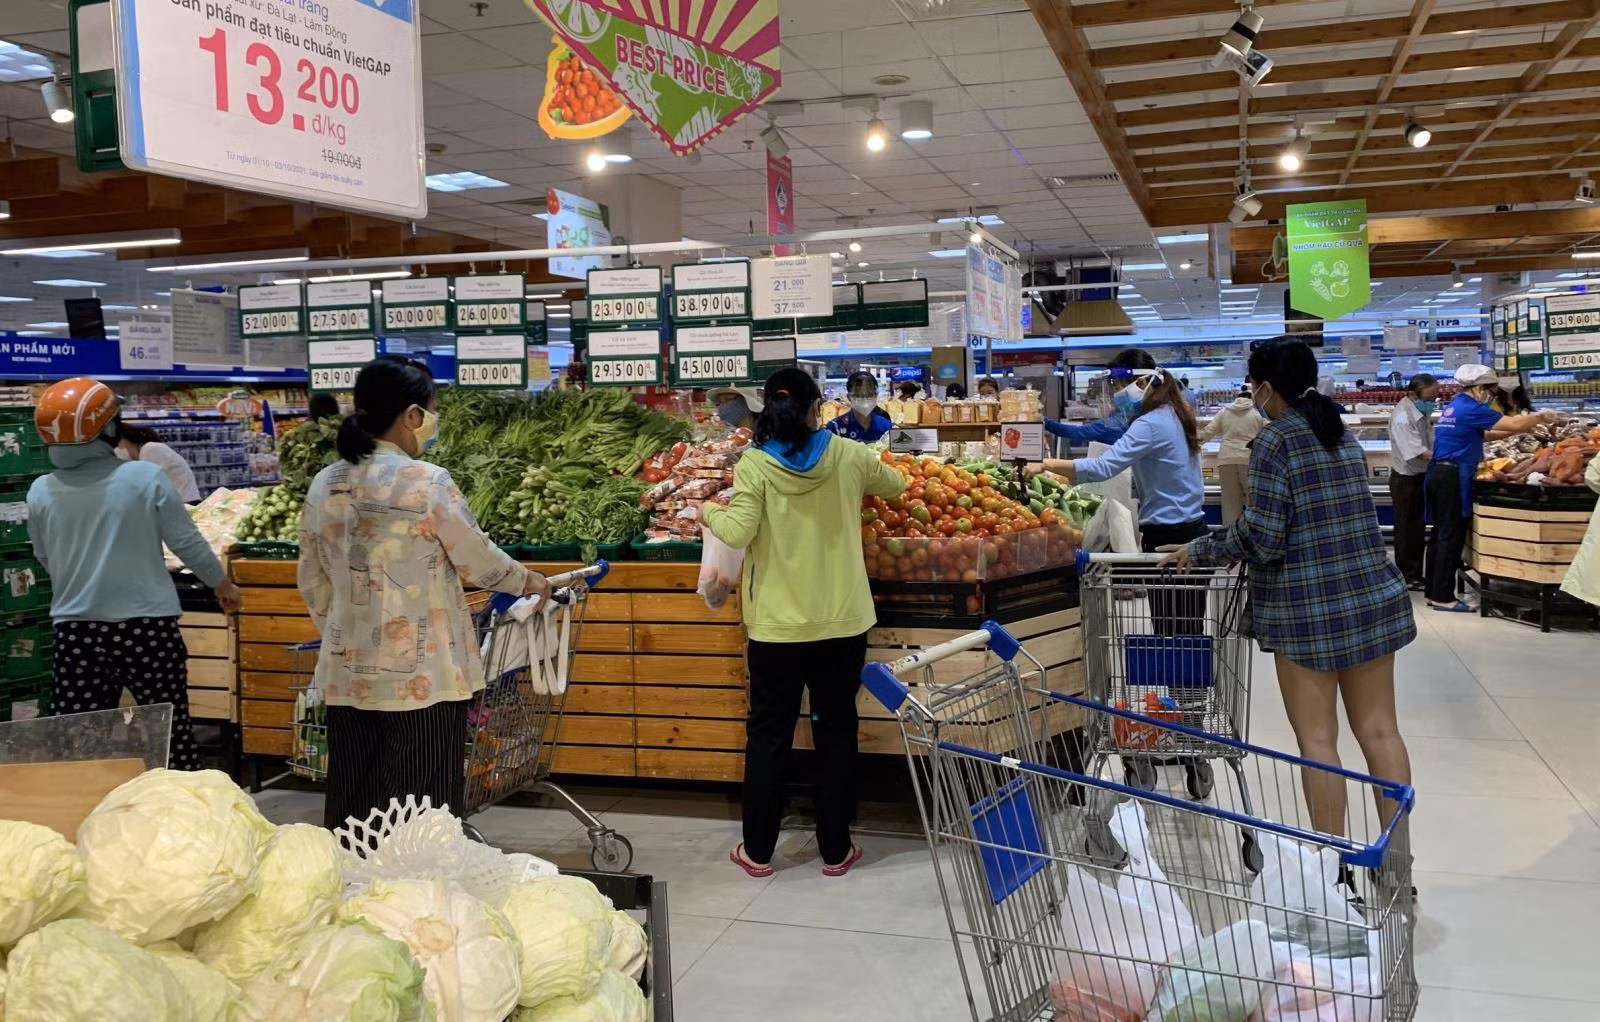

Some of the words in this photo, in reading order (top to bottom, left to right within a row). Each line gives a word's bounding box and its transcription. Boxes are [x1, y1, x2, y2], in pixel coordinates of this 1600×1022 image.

[282, 8, 297, 25] Lạt
[304, 16, 323, 33] Lâm
[205, 2, 246, 29] phẩm
[249, 17, 273, 40] đạt
[275, 26, 300, 47] tiêu
[303, 38, 341, 62] chuẩn
[343, 48, 391, 77] VietGAP
[615, 33, 668, 77] BEST
[673, 53, 727, 97] PRICE
[311, 113, 346, 146] đ/kg
[1303, 217, 1351, 229] VietGAP
[593, 301, 645, 317] 23.900
[679, 296, 732, 313] 38.900
[312, 312, 357, 328] 27.500
[388, 309, 434, 324] 50.000
[460, 306, 508, 321] 26.000
[1551, 314, 1590, 327] 33.900
[244, 314, 288, 330] 52.000
[52, 342, 76, 356] MỚI
[681, 358, 734, 375] 45.000
[1554, 355, 1593, 367] 32.000
[460, 366, 509, 382] 21.000
[593, 363, 644, 379] 29.500
[902, 368, 923, 378] pepsi
